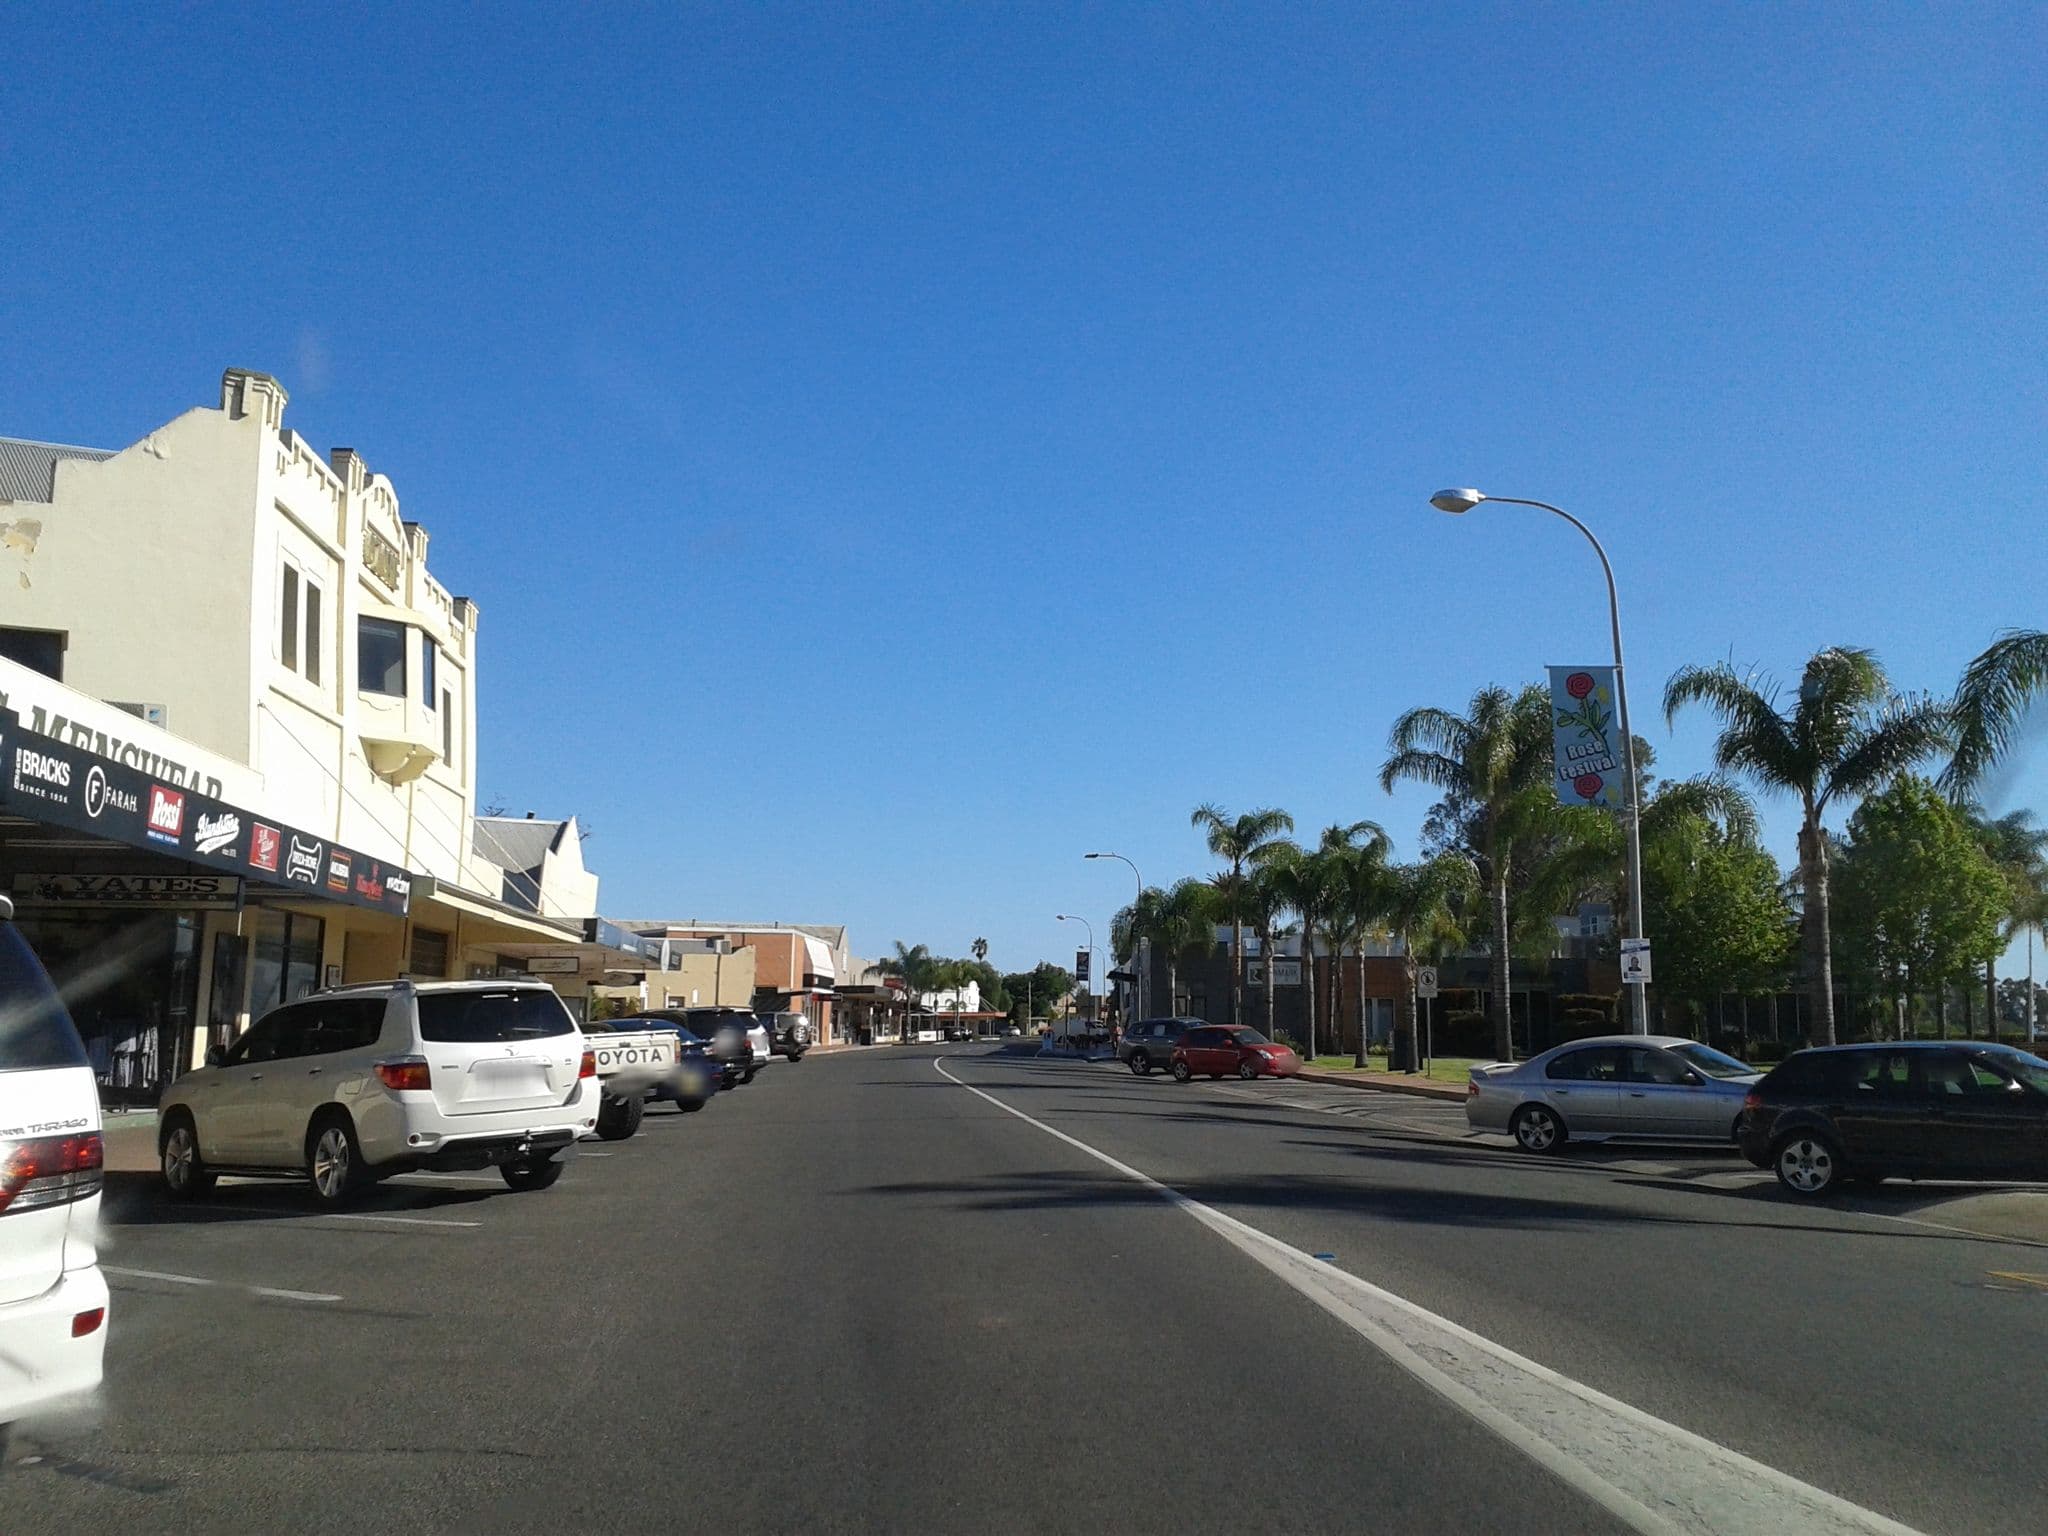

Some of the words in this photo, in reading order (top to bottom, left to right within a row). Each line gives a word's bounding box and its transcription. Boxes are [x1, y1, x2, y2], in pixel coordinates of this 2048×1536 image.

[1567, 741, 1603, 760] Rose
[22, 749, 71, 787] BRACKS
[1559, 753, 1617, 781] Festival
[20, 783, 46, 798] SINCE
[91, 780, 101, 803] F
[105, 786, 138, 813] FARAH
[151, 791, 183, 831] Rossi
[75, 877, 220, 893] YATES
[598, 1048, 662, 1065] OYOTA
